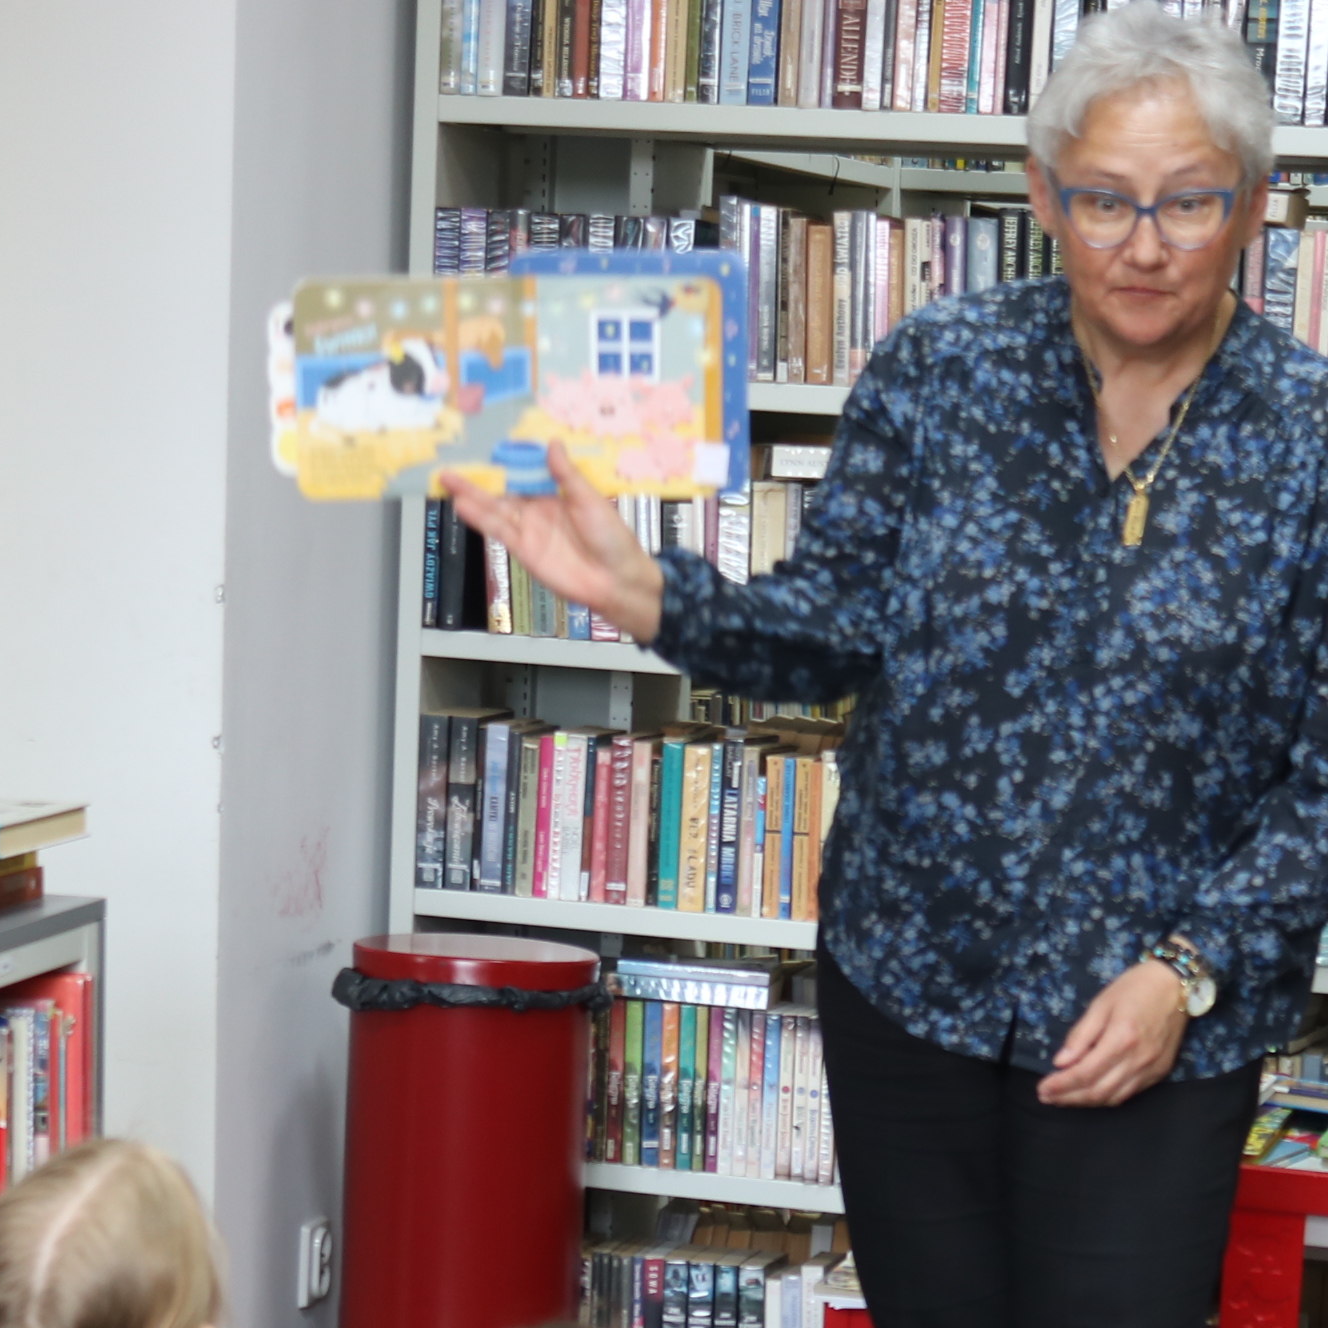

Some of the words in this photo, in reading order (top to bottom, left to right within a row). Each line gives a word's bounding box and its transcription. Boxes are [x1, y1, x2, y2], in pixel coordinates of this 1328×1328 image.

[729, 13, 744, 46] BRICK
[837, 14, 861, 85] ALLENDE
[727, 51, 742, 83] LANE
[1005, 216, 1018, 249] JEFFREY
[836, 298, 846, 337] Anthony
[835, 339, 845, 370] Evelyn
[780, 458, 804, 468] LYNN
[424, 552, 438, 599] GWIAZDY
[432, 723, 441, 742] Amy
[461, 724, 469, 743] Amy
[722, 788, 738, 842] LATARNIA
[648, 1264, 658, 1297] SOWA
